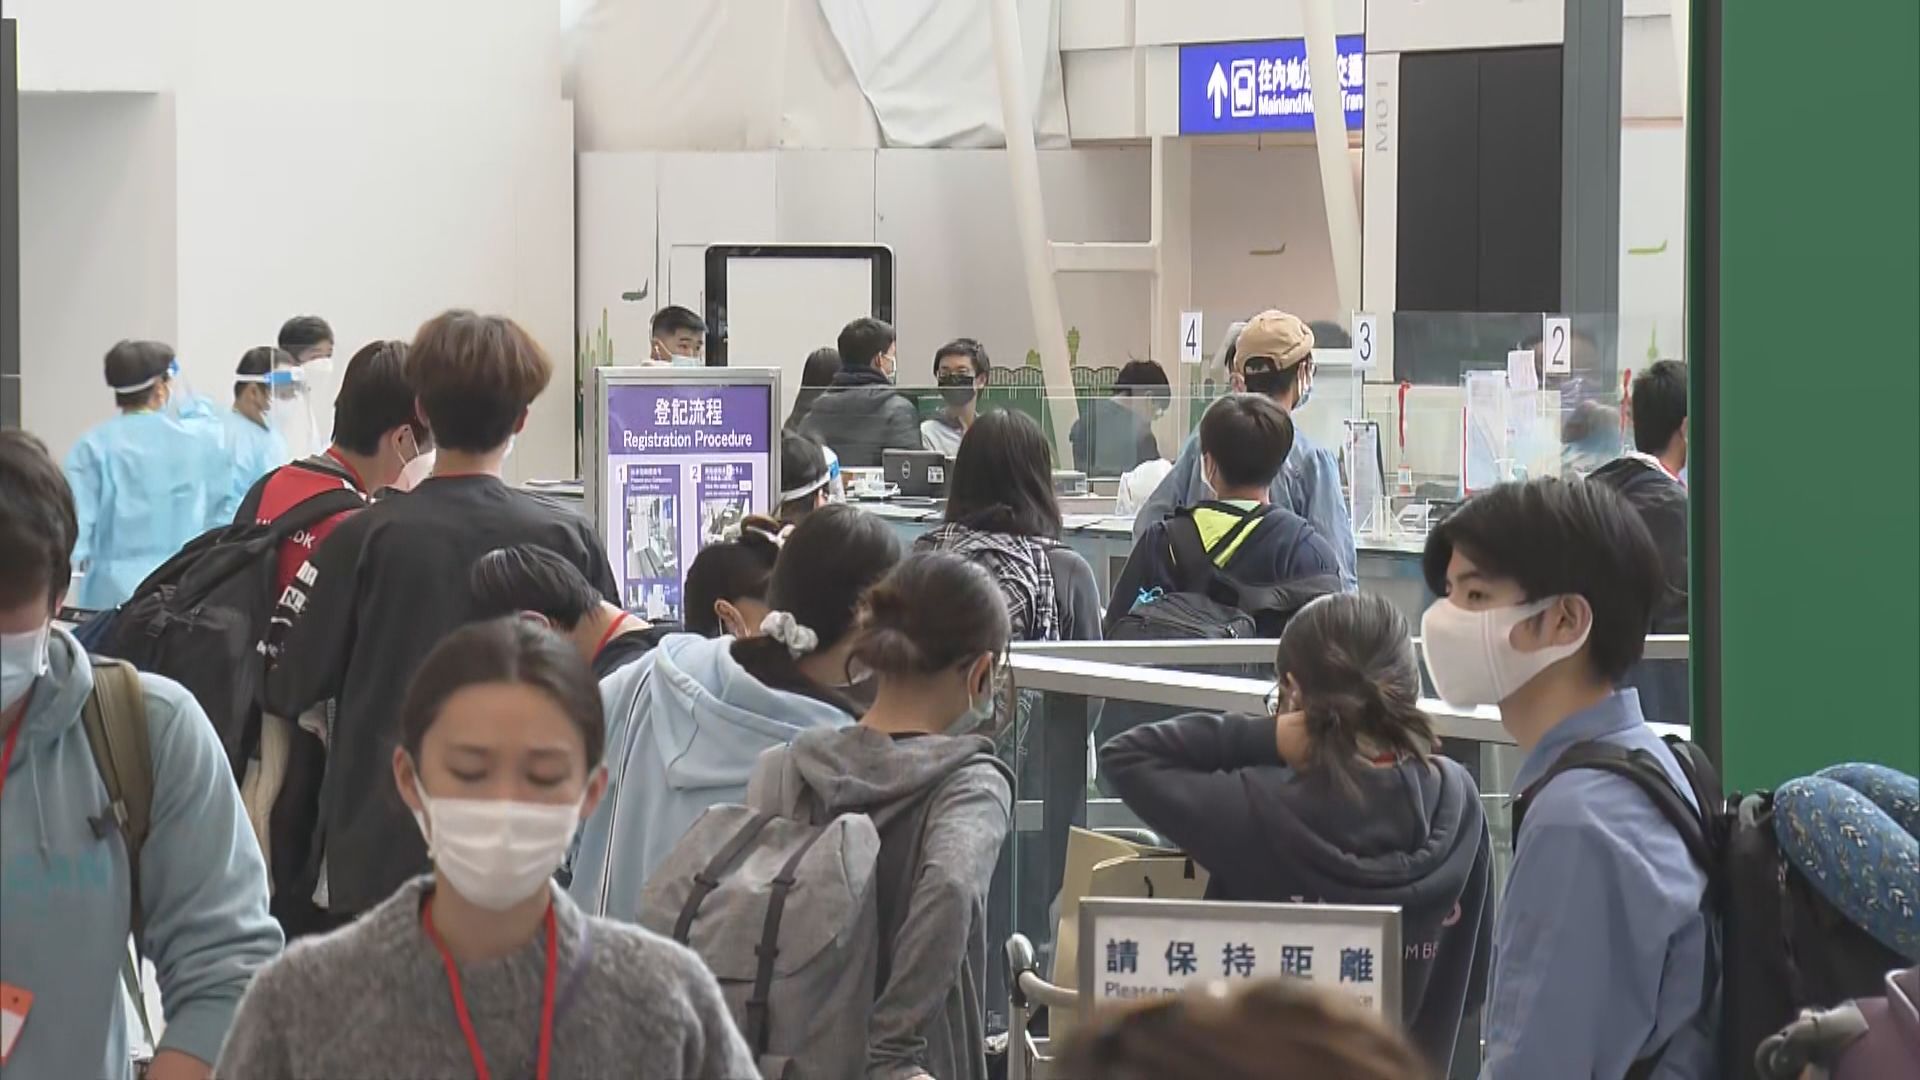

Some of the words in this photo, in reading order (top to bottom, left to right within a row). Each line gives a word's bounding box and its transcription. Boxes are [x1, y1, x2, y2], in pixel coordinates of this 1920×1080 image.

[1258, 92, 1314, 116] Mainland/M
[1341, 90, 1363, 112] Tran
[1185, 318, 1197, 357] 4
[1359, 321, 1372, 361] 3
[1552, 325, 1565, 366] 2
[654, 397, 723, 426] 登記流程
[623, 430, 691, 451] Registration
[694, 429, 753, 448] Procedure
[691, 465, 699, 480] 2
[1106, 937, 1375, 984] 請保持距離
